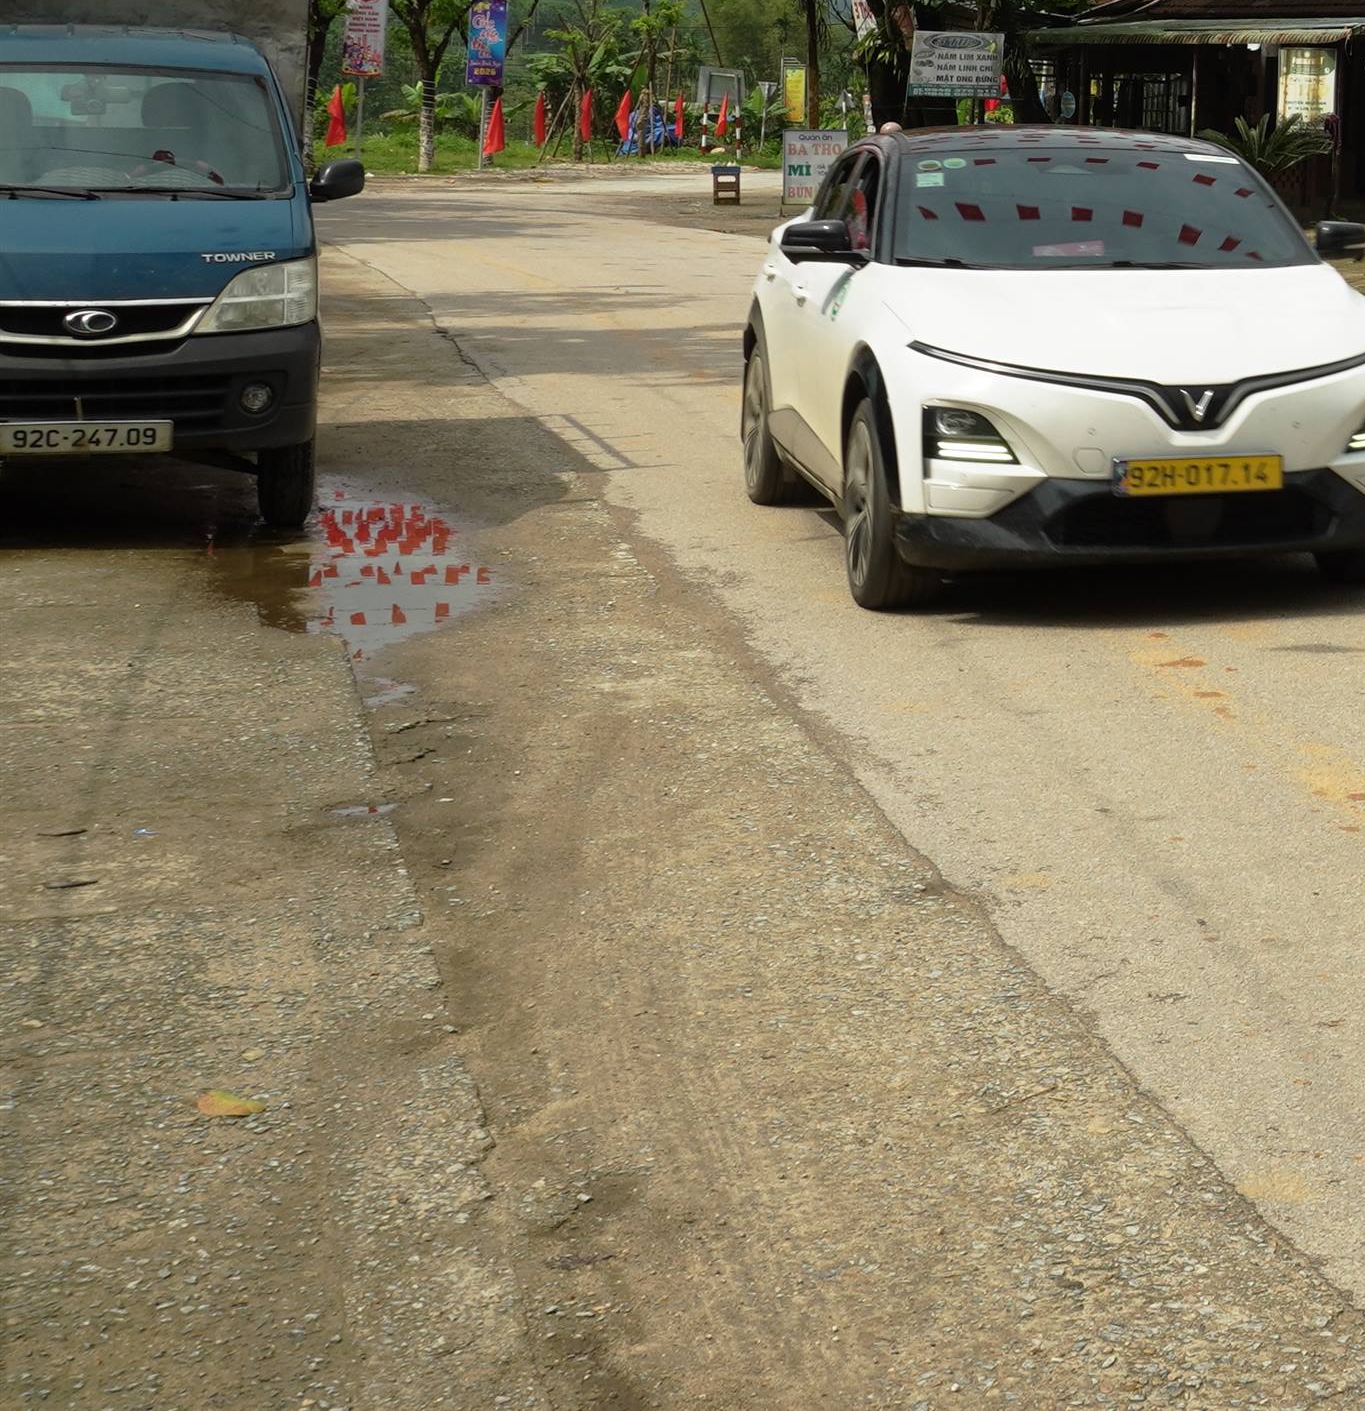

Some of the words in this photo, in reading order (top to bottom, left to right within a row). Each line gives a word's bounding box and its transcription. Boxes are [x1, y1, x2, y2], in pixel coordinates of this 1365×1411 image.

[788, 143, 808, 156] BA
[787, 161, 812, 176] MÌ
[201, 251, 276, 263] TOWNER
[12, 427, 157, 449] 92C-247.09
